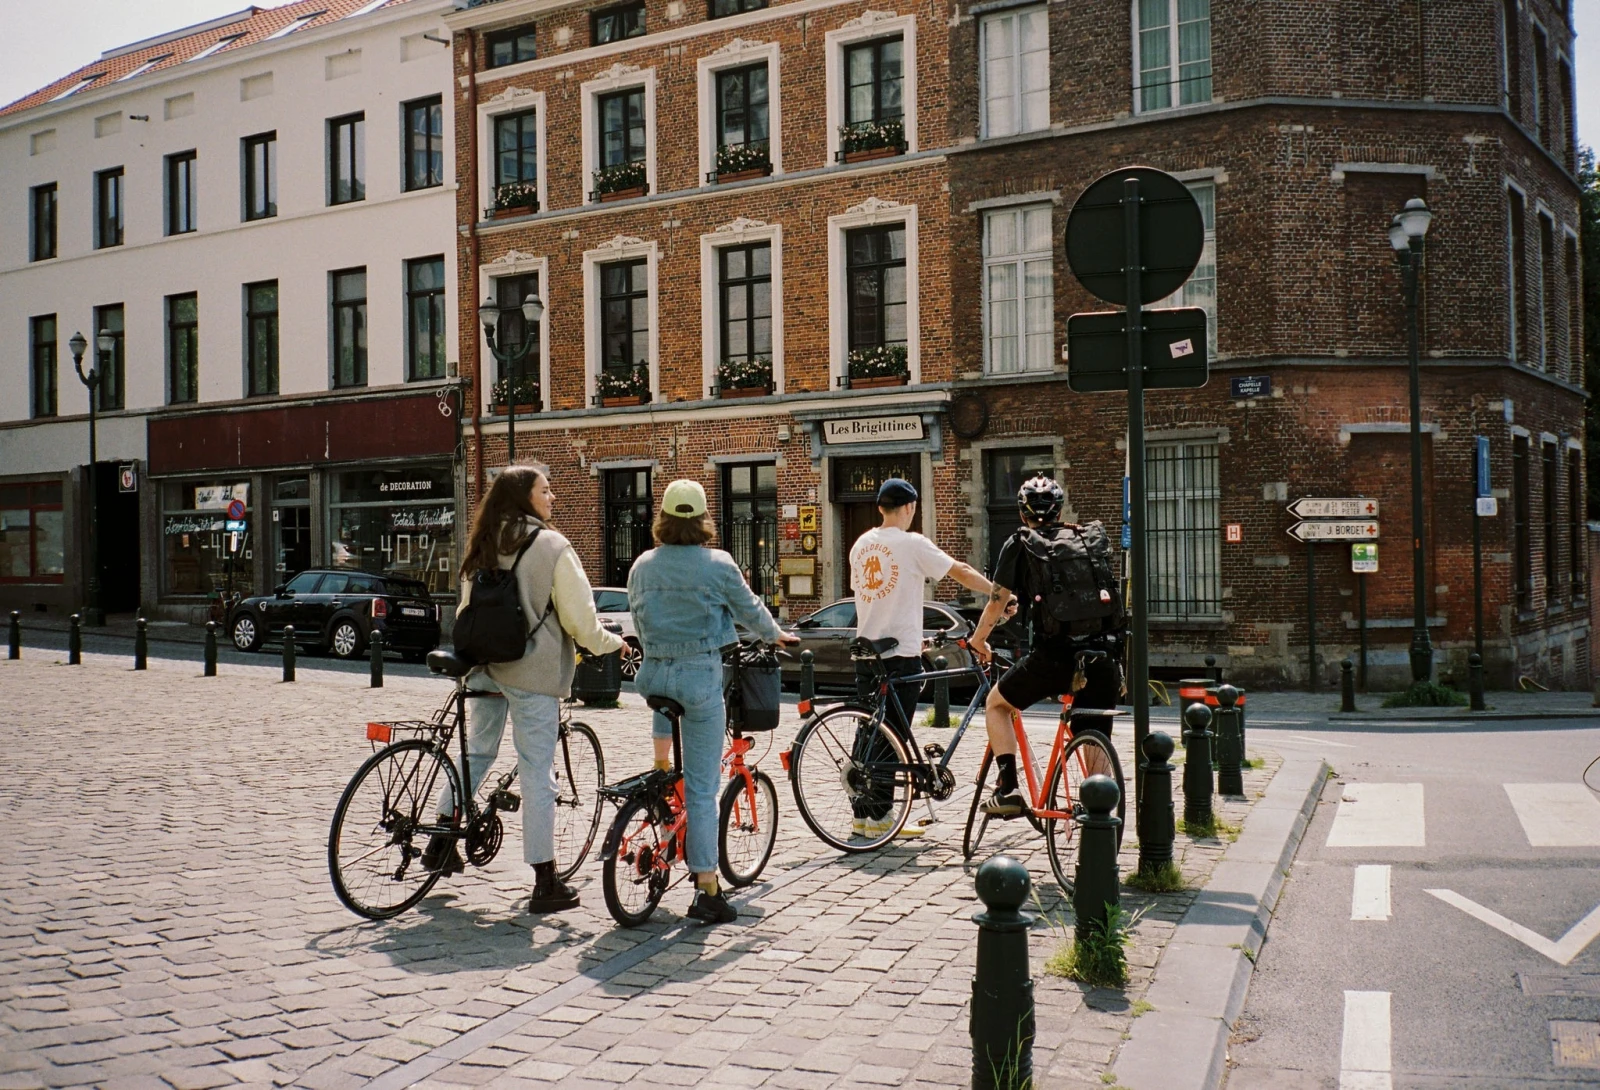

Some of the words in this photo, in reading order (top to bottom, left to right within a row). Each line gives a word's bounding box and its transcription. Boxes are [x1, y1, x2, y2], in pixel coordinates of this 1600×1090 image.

[831, 422, 849, 435] Les
[852, 420, 917, 435] Brigittines
[380, 483, 388, 491] de
[389, 481, 432, 491] DECORATION
[1341, 501, 1360, 509] PIERRE
[1229, 527, 1238, 539] H
[1335, 525, 1366, 536] BORDET
[857, 543, 893, 560] GOLDBLOK
[875, 564, 899, 600] BRUSSEL
